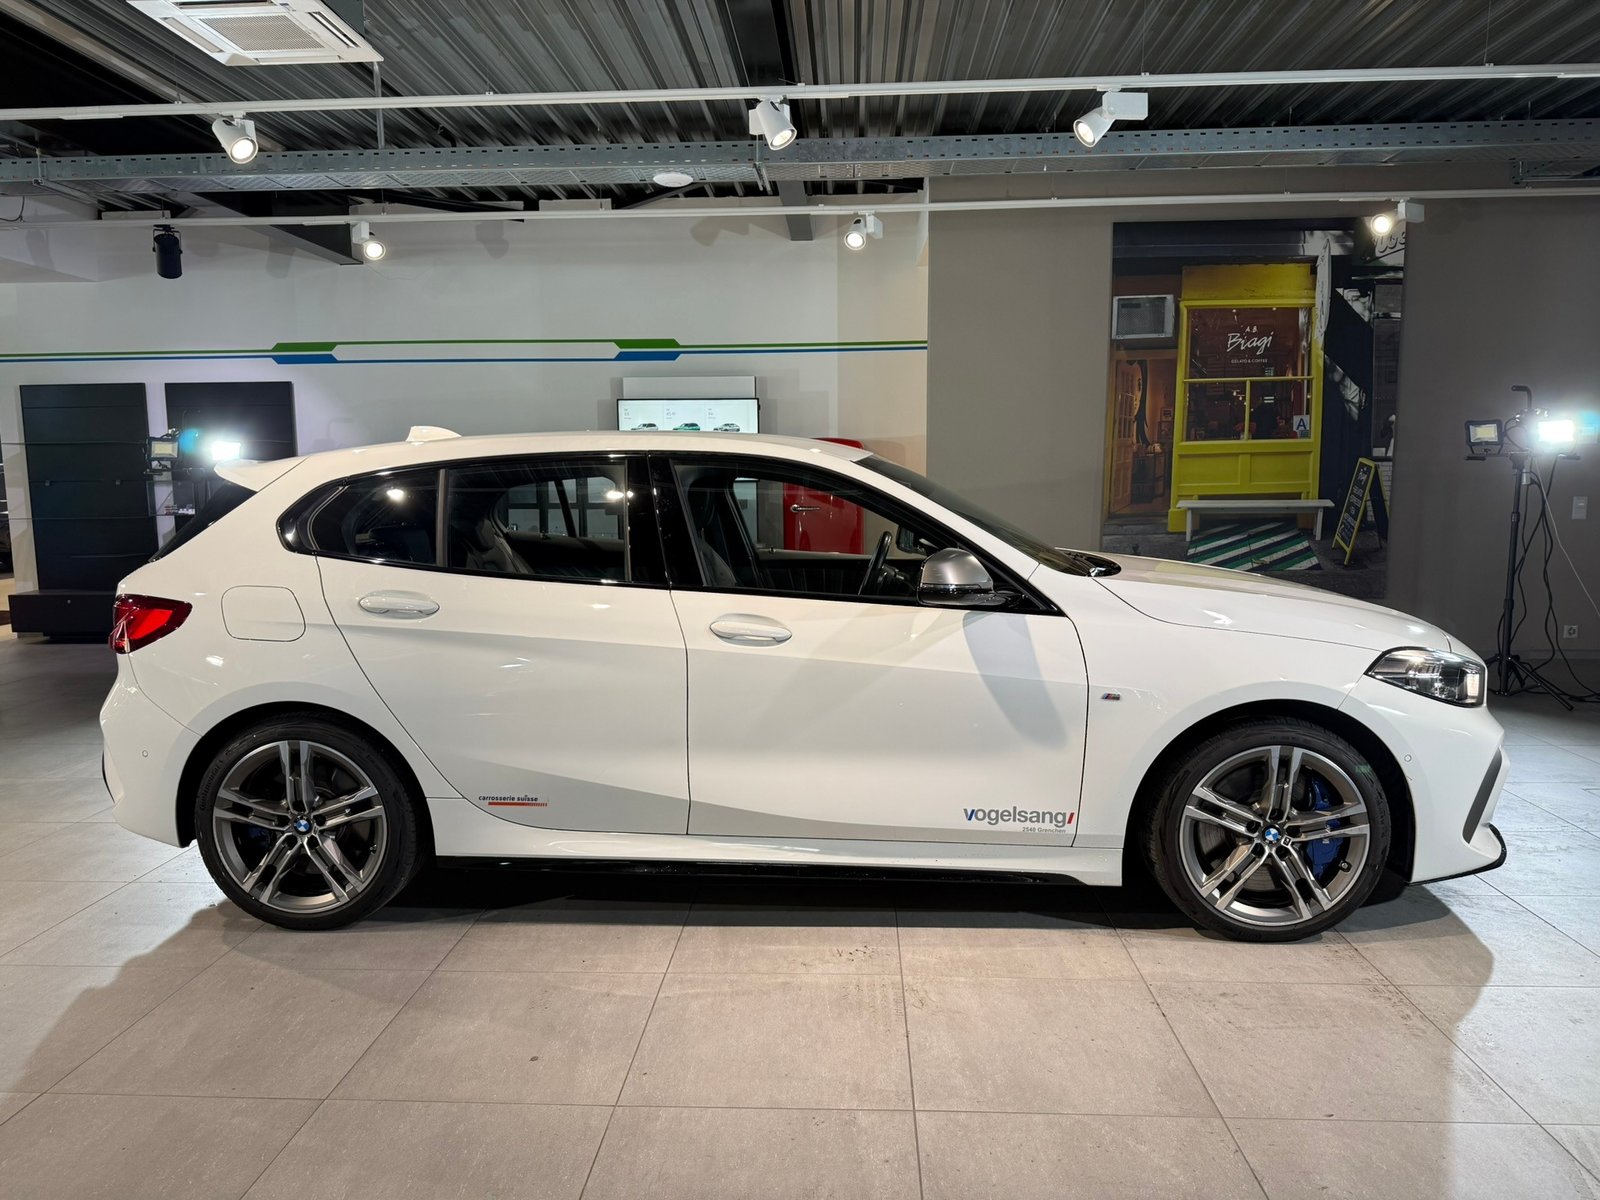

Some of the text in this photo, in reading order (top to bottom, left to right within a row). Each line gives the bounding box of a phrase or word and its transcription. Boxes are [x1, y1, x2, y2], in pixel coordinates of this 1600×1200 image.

[1227, 331, 1274, 355] Biagi
[1295, 417, 1307, 431] A
[516, 794, 539, 802] suisse
[963, 806, 1067, 828] vogelsang
